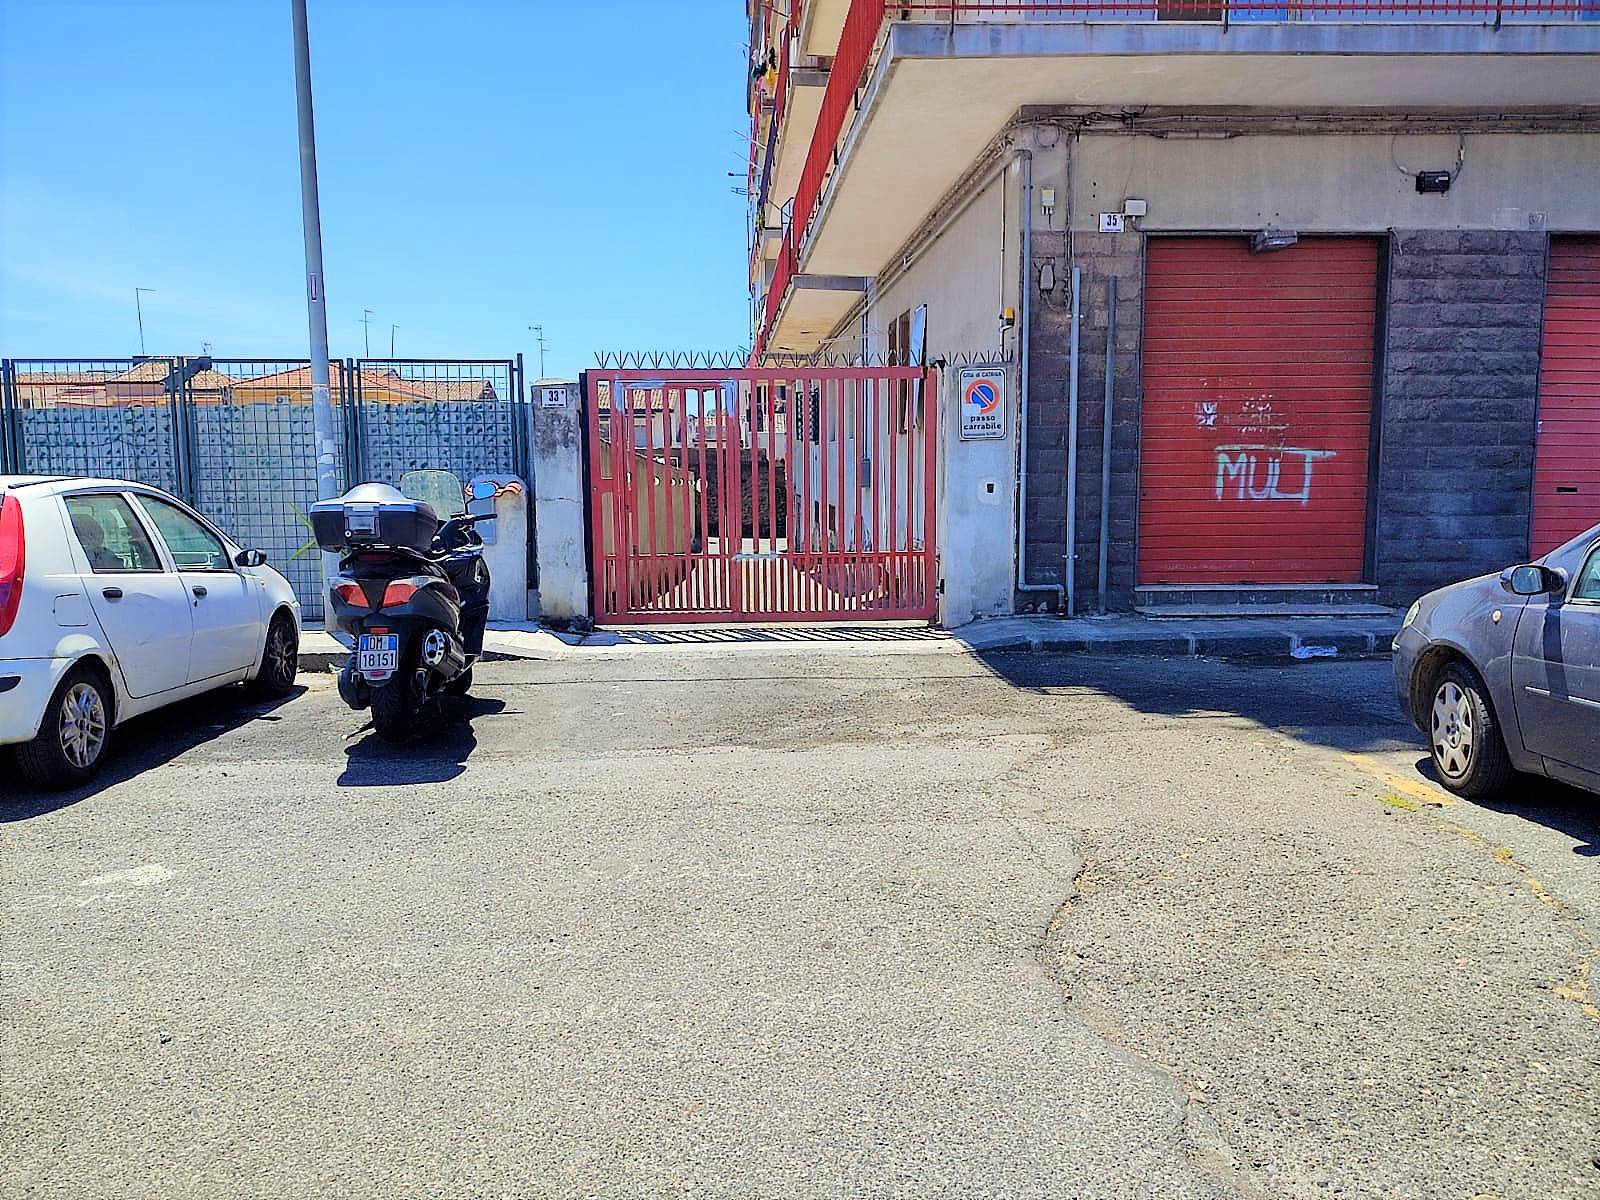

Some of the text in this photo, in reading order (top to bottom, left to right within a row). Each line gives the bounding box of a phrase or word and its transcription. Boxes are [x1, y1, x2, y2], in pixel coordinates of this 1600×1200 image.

[1107, 214, 1118, 226] 35
[548, 390, 559, 401] 33
[970, 415, 996, 423] passo
[963, 422, 1002, 430] carrabile
[369, 636, 383, 650] DM
[362, 653, 394, 667] 18151
